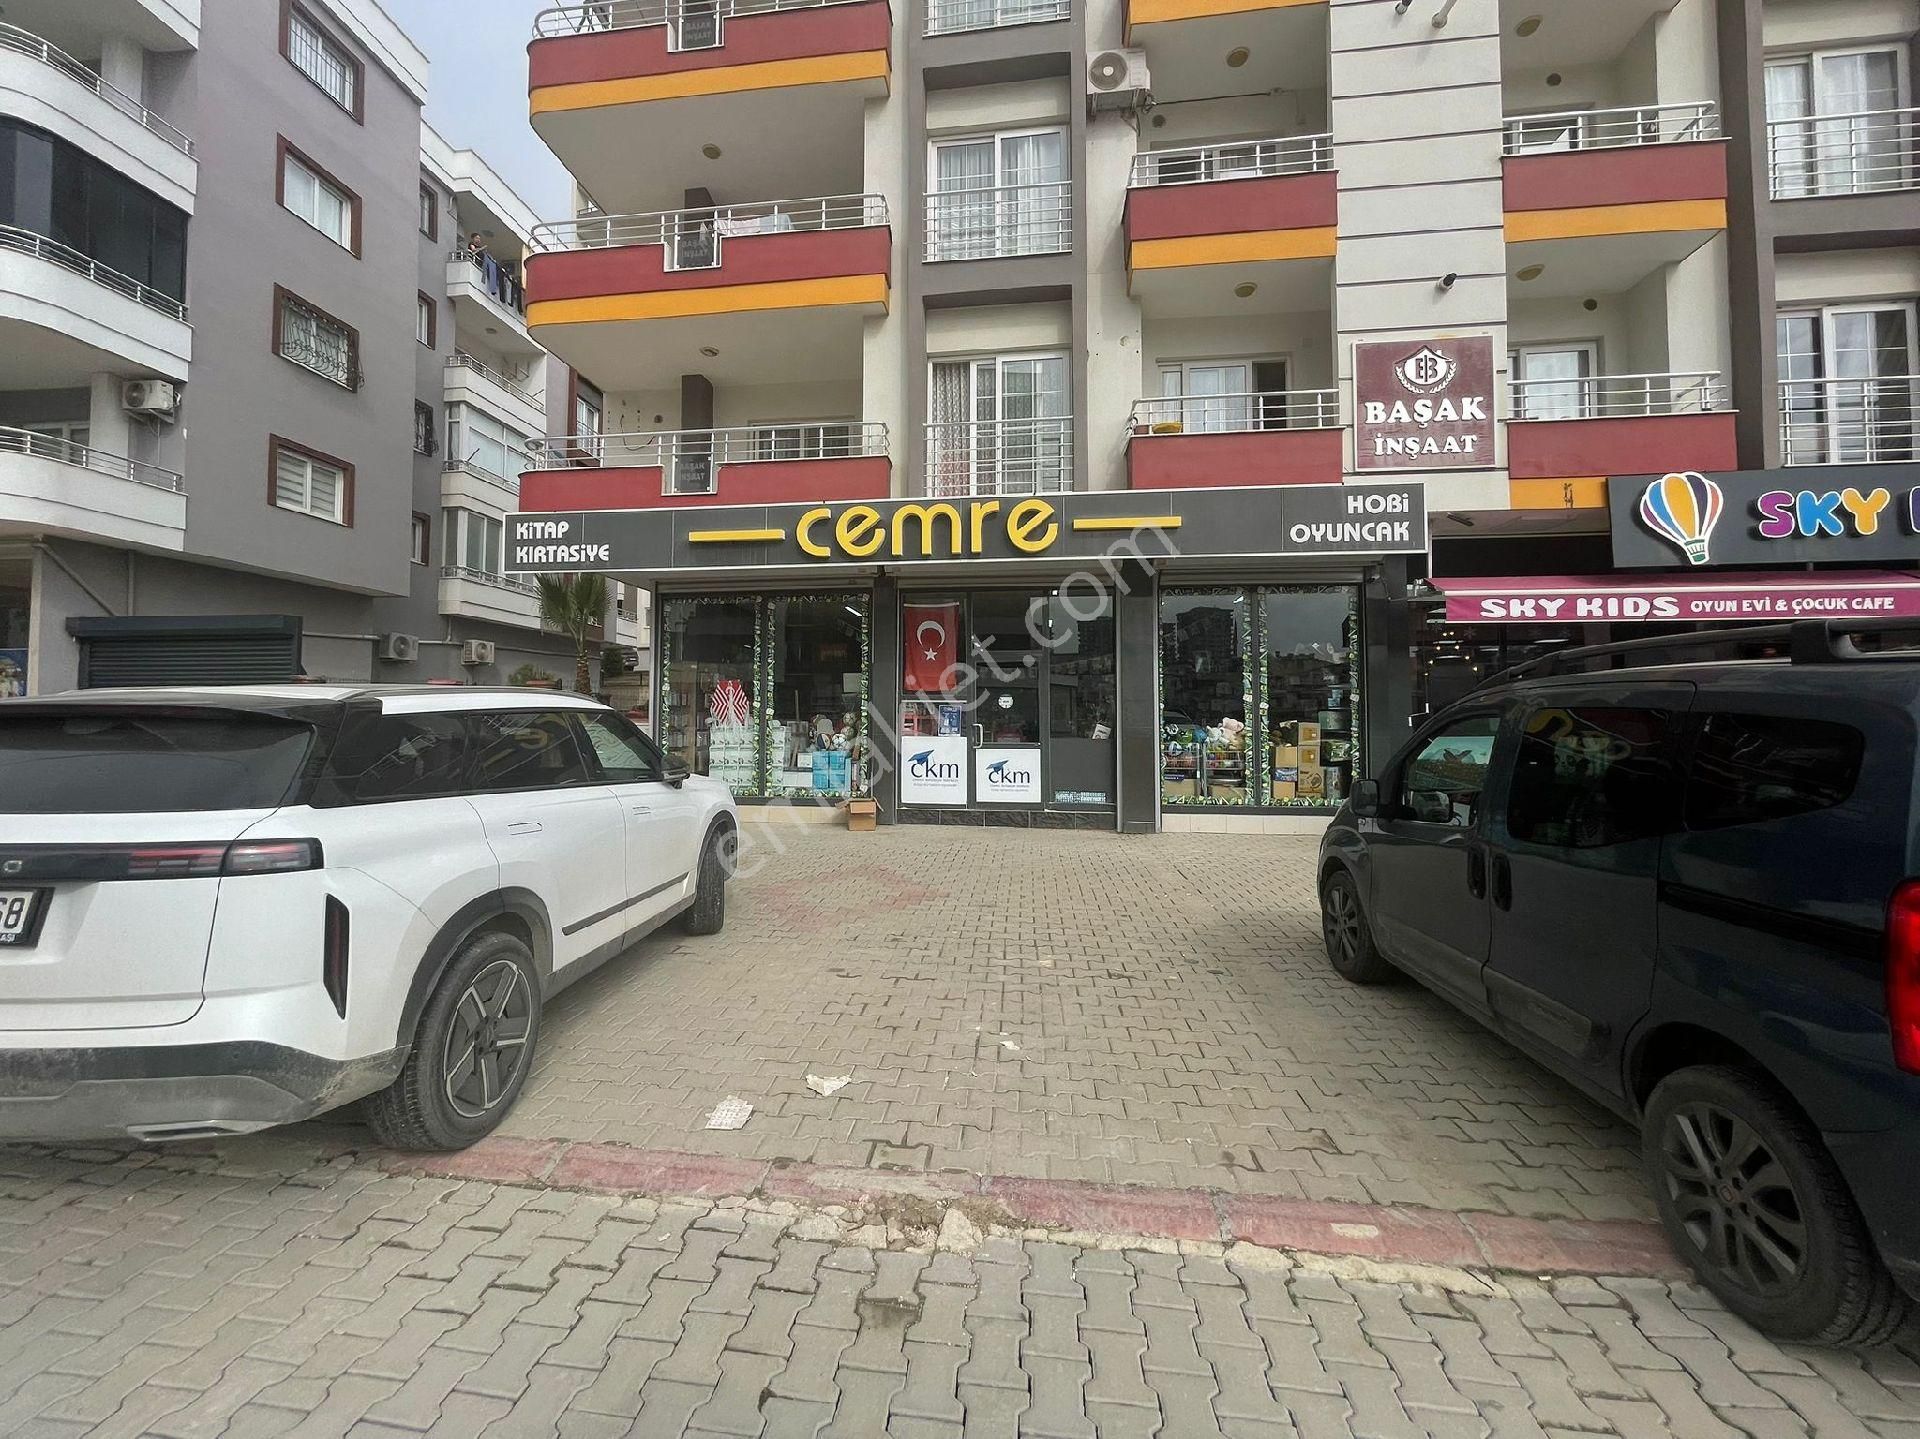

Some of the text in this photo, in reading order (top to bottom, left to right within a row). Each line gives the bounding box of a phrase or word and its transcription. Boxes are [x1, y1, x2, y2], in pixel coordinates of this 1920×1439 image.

[1364, 397, 1487, 428] BAŞAK
[1374, 433, 1478, 460] İNŞAAT
[1757, 487, 1891, 538] SKY
[796, 499, 1059, 557] cemre
[1289, 521, 1410, 543] OYUNCAK
[1480, 596, 1895, 618] SKY KIDS OYUN EVİ & ÇOCUK CAFE
[911, 757, 959, 779] ckm
[988, 764, 1031, 784] ckm
